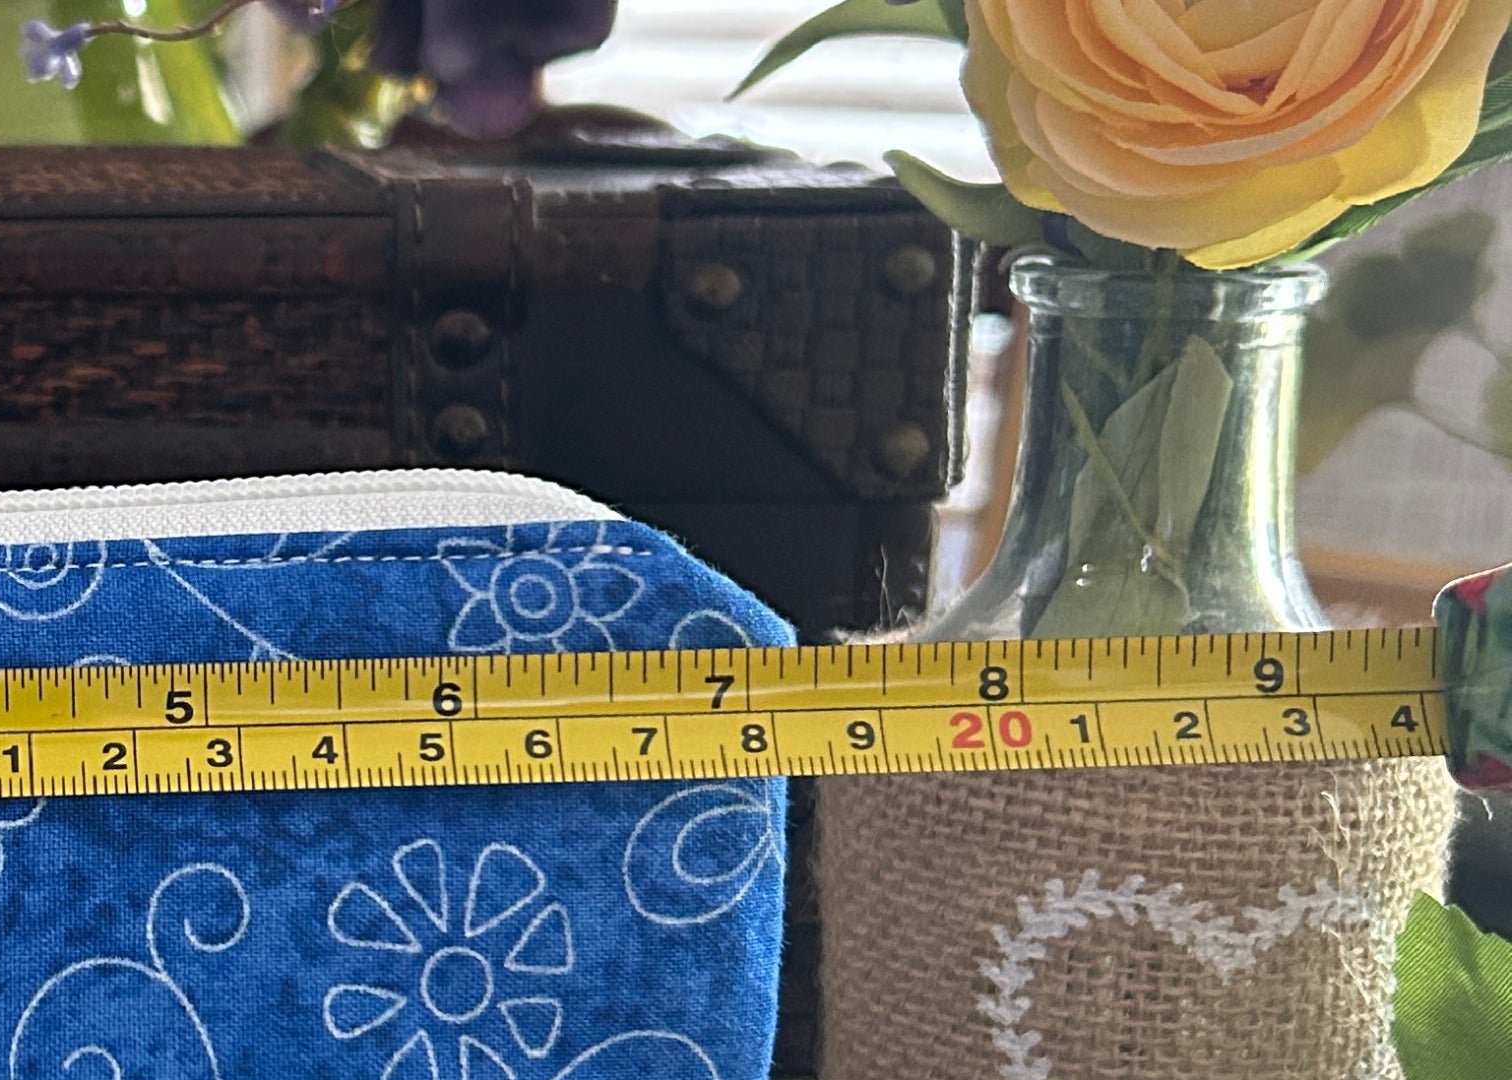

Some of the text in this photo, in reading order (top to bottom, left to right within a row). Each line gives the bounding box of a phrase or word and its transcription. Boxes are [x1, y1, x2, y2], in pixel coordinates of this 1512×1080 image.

[165, 691, 194, 724] 5
[432, 682, 463, 717] 6
[705, 675, 735, 709] 7
[978, 666, 1009, 701] 8
[1253, 658, 1284, 693] 9
[2, 745, 21, 773] 1
[102, 742, 128, 771] 2
[206, 738, 234, 767] 3
[311, 736, 339, 764] 4
[418, 733, 445, 761] 5
[524, 729, 552, 758] 6
[631, 727, 659, 756] 7
[740, 724, 768, 753] 8
[846, 721, 875, 750] 9
[1070, 715, 1089, 744] 1
[1173, 712, 1200, 740] 2
[1282, 708, 1311, 737] 3
[1390, 705, 1419, 733] 4
